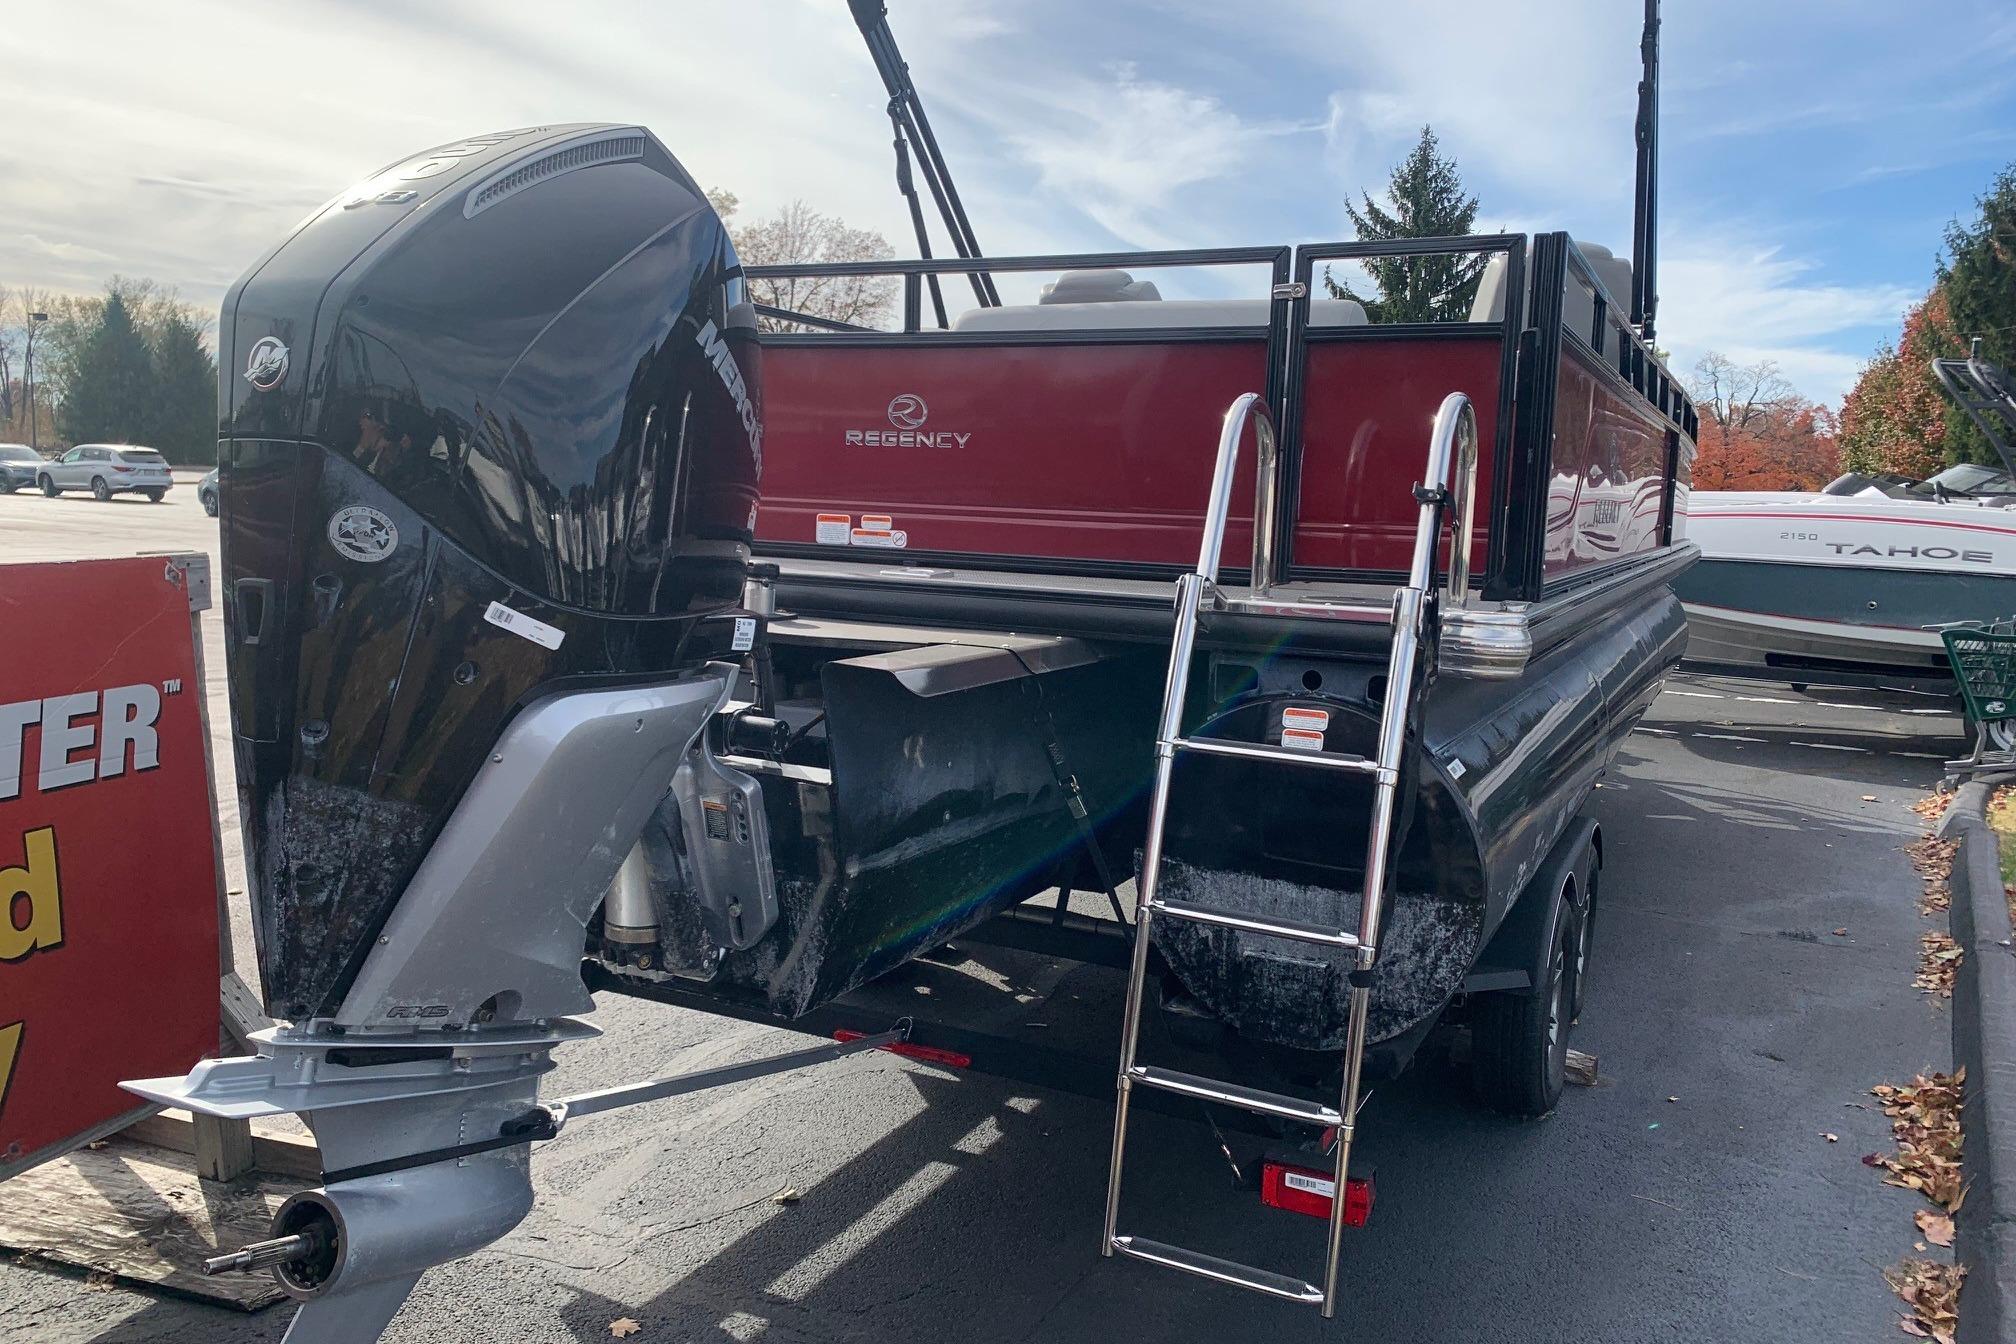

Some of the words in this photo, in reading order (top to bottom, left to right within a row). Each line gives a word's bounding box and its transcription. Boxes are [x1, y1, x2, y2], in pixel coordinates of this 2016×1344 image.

[695, 318, 763, 483] MERCU
[846, 430, 971, 448] REGENCY
[1780, 531, 1818, 541] 2150
[1826, 544, 1993, 563] TAHOE
